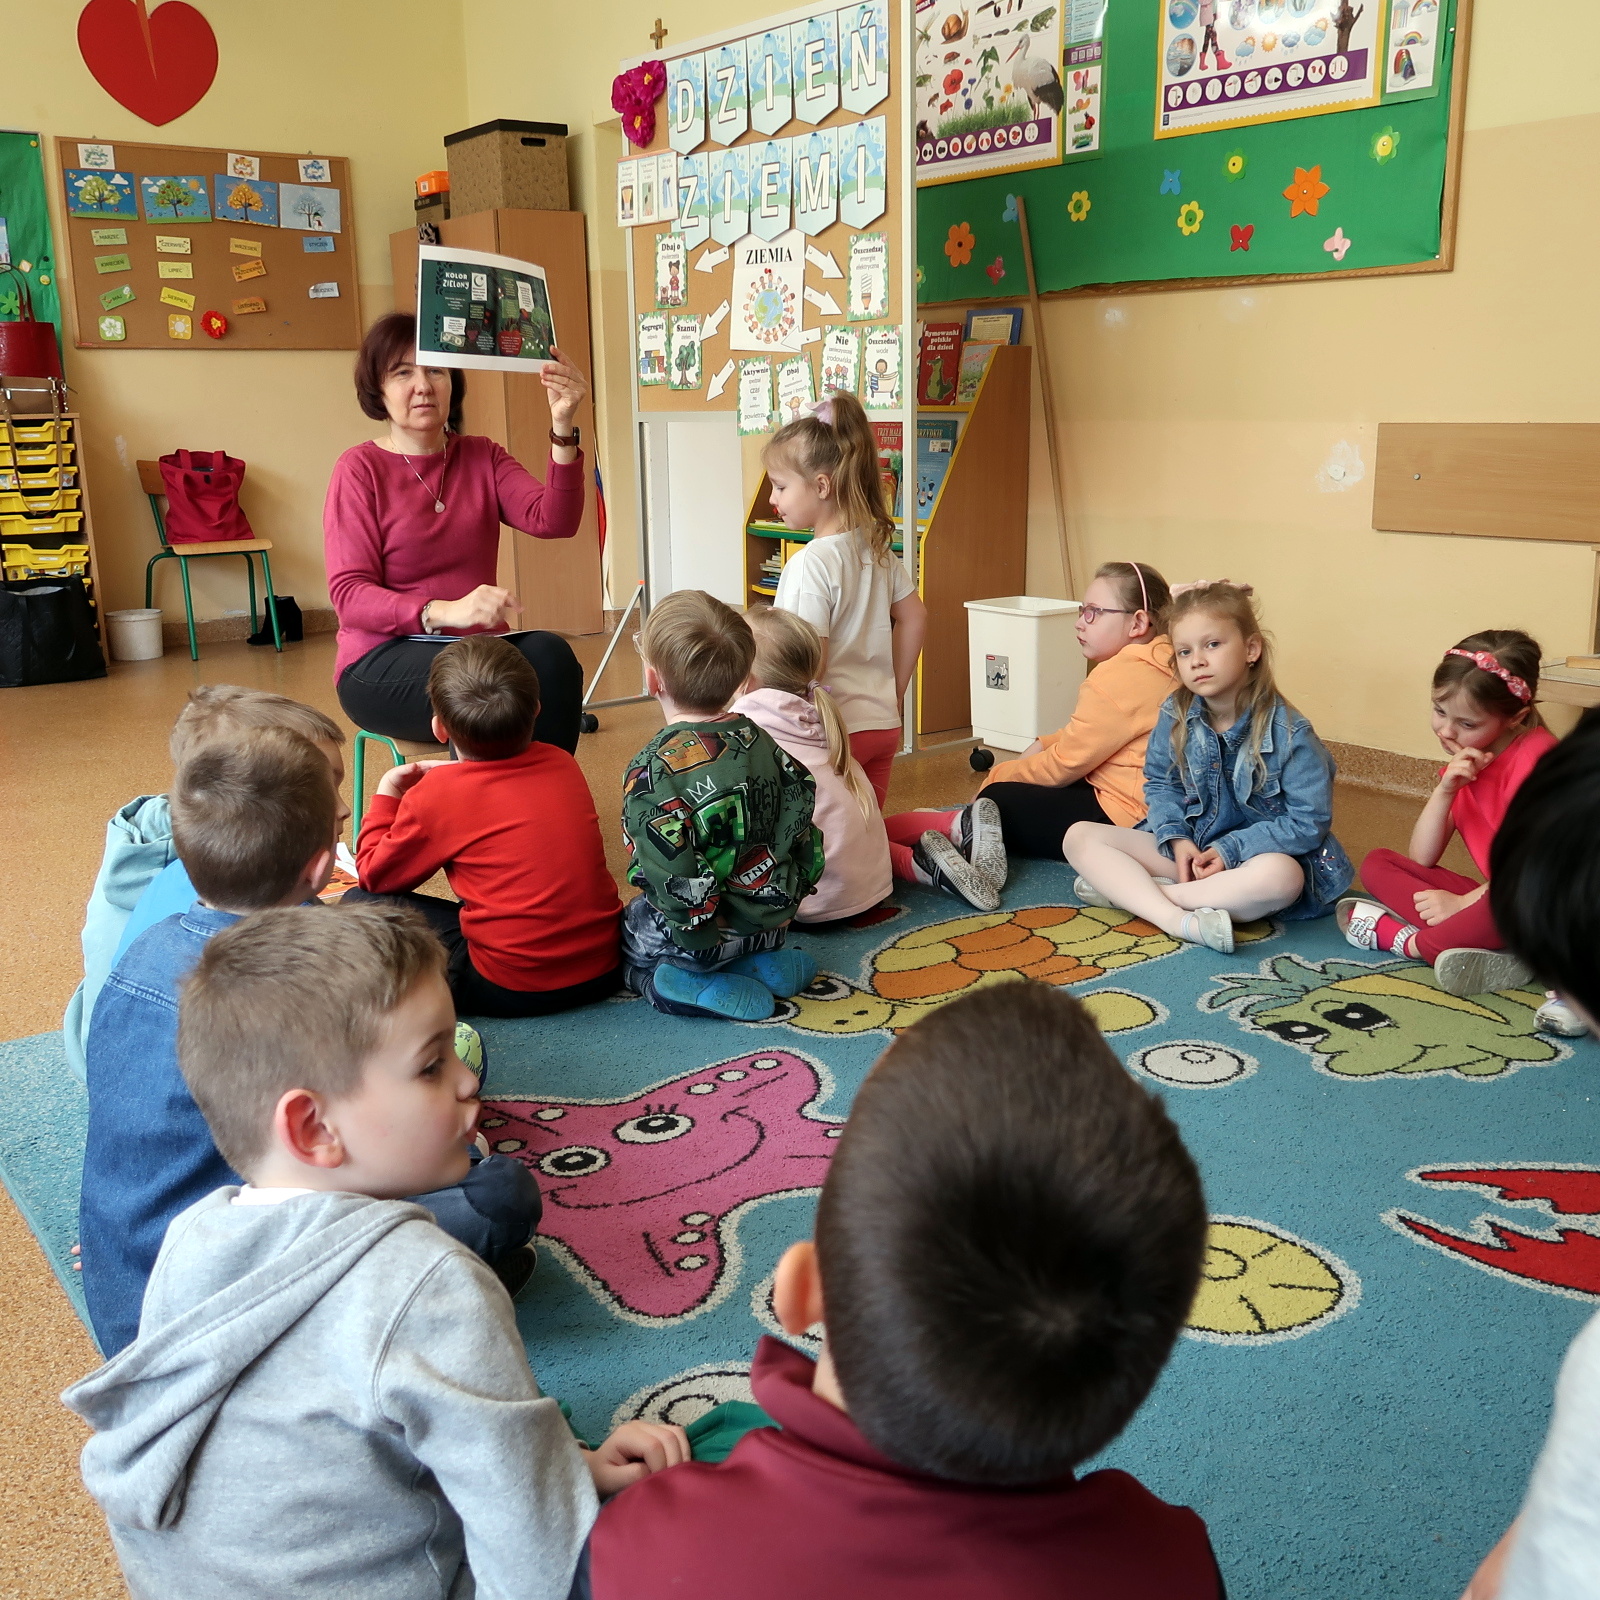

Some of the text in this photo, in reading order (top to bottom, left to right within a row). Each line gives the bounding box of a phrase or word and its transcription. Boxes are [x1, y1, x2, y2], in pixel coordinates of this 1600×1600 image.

[676, 10, 877, 133] DZIEŃ
[678, 144, 866, 229] ZIEMI
[661, 243, 676, 252] Dbaj
[746, 247, 793, 265] ZIEMIA
[445, 272, 468, 280] KOLOR
[641, 323, 664, 333] Segreguj
[676, 324, 697, 333] Szanuj
[925, 329, 959, 338] Rymowanki
[835, 335, 849, 346] Nie
[930, 337, 952, 345] polskie
[742, 367, 769, 376] Aktywnie
[786, 366, 800, 376] Dbaj
[744, 412, 766, 420] powietrzu
[877, 427, 889, 437] TRZY
[637, 805, 665, 827] ZOM
[784, 812, 811, 841] ZOMB
[742, 860, 769, 882] TNT
